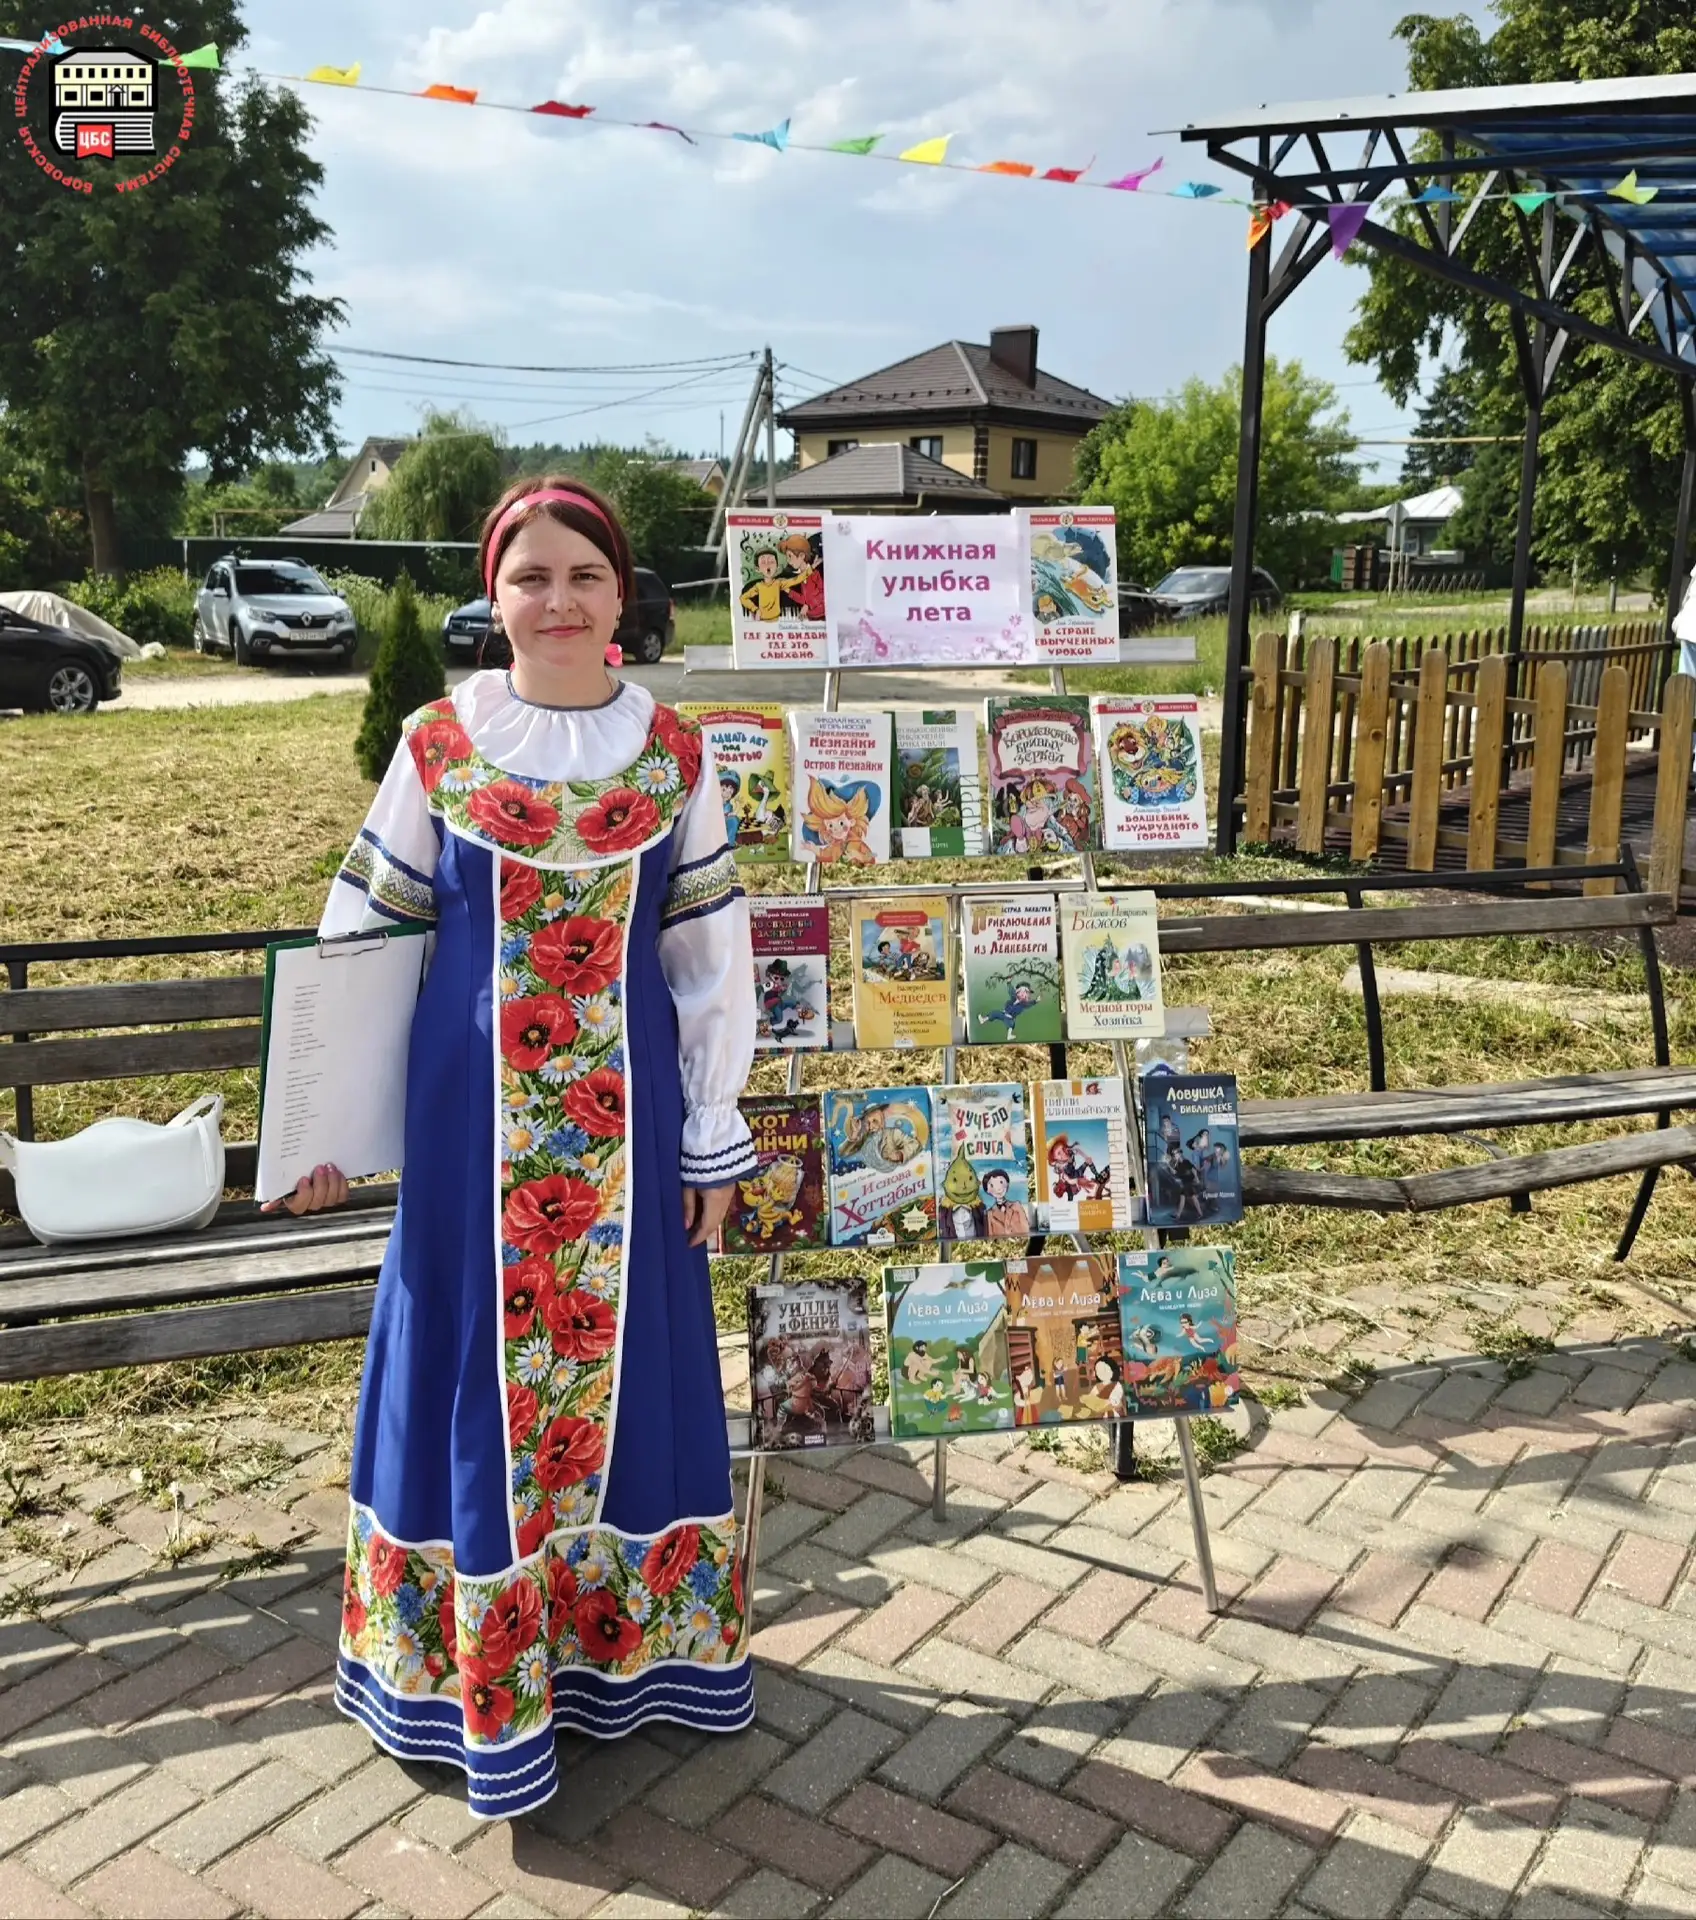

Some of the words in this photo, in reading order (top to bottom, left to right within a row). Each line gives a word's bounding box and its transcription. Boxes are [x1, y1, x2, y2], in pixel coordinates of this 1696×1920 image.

[866, 540, 996, 560] Книжная
[881, 569, 990, 597] улыбка
[906, 606, 971, 621] лета
[744, 632, 761, 640] ГДЕ
[765, 632, 784, 640] ЭТО
[788, 632, 827, 640] ВИДАН
[1056, 627, 1096, 635] СТРАНЕ
[769, 641, 787, 649] ГДЕ
[790, 641, 809, 649] ЭТО
[1035, 637, 1115, 646] ЕВЫУЧЕННЫХ
[1048, 648, 1092, 656] УРОКОВ
[711, 732, 747, 744] АДЦАТЬ
[809, 737, 876, 749] Незнайки
[1003, 726, 1078, 749] КОРОЛЕВСТВО
[714, 751, 763, 762] ОВАТЬЮ
[1013, 750, 1065, 765] ЗЕРКАЛ
[804, 759, 836, 771] Остров
[838, 760, 883, 771] Незнайки
[1125, 814, 1189, 822] ВОЛШЕБНИК
[1117, 823, 1199, 832] ИЗУМРУДНОГО
[1137, 832, 1180, 841] ГОРОДА
[1071, 911, 1127, 931] Бажов
[997, 929, 1029, 941] ЭМИЛЯ
[974, 945, 986, 955] ИЗ
[880, 991, 947, 1005] Медведев
[1080, 1001, 1122, 1013] Медной
[1125, 1004, 1153, 1014] горы
[1094, 1015, 1142, 1026] Хозяйка
[1180, 1103, 1233, 1114] БИБЛИОТЕКЕ
[749, 1114, 789, 1129] КОТ
[956, 1107, 1009, 1130] ЧУЧЕЛО
[754, 1134, 808, 1152] ИНЧИ
[966, 1141, 1004, 1155] СЛУГА
[862, 1181, 875, 1197] И
[876, 1169, 911, 1190] снова
[834, 1178, 926, 1233] Хоттабыч
[779, 1300, 839, 1319] УИЛЛИ
[788, 1315, 840, 1331] ФЕНРИ
